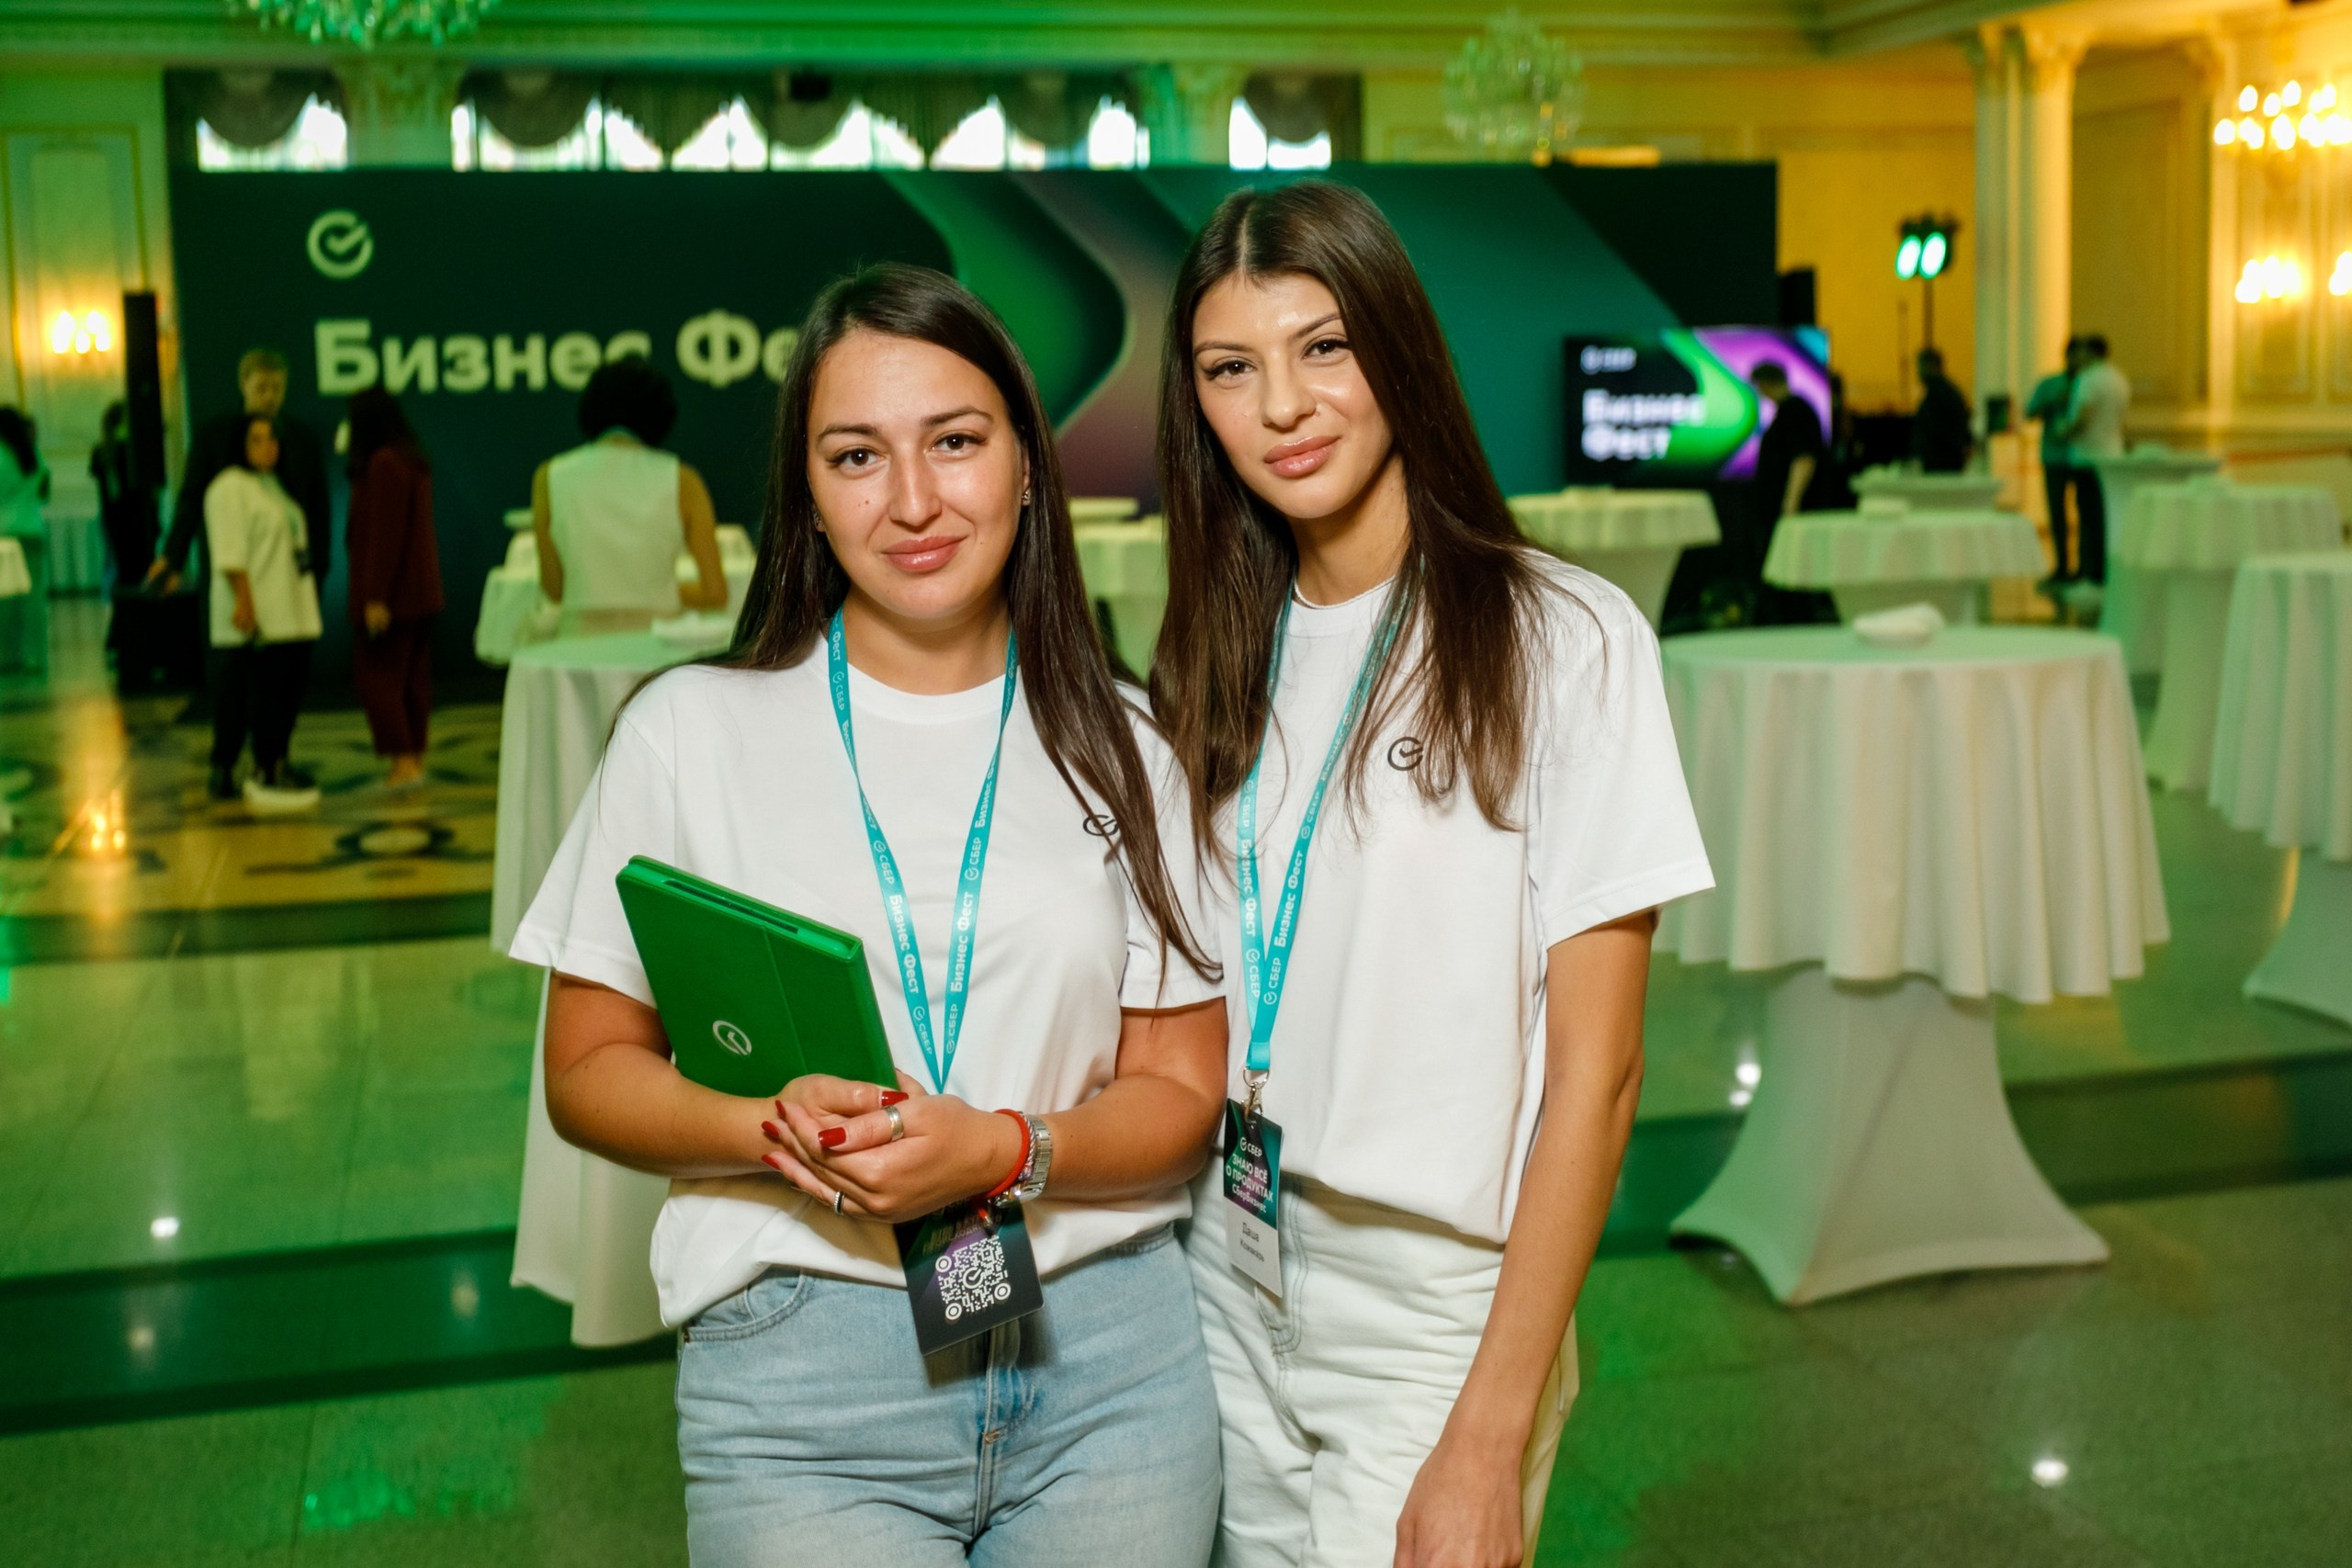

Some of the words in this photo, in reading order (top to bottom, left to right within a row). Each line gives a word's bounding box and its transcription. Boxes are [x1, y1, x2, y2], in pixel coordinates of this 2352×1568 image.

[674, 308, 795, 388] Фе
[831, 631, 842, 661] Фест
[835, 685, 845, 711] СБЕР
[975, 781, 992, 829] Бизнес
[969, 837, 982, 865] СБЕР
[1241, 839, 1254, 895] Бизнес
[1288, 850, 1304, 889] Фест
[956, 891, 974, 931] Фест
[1244, 897, 1257, 937] Фест
[1273, 892, 1296, 948] Бизнес
[879, 854, 896, 886] СБЕР
[888, 895, 910, 952] Бизнес
[903, 953, 920, 994] Фест
[918, 1022, 933, 1056] СБЕР
[950, 935, 969, 993] Бизнес
[1269, 957, 1282, 989] СБЕР
[1249, 965, 1261, 998] СБЕР
[947, 1003, 959, 1037] СБЕР
[1232, 1154, 1253, 1174] ЗНАЮ
[1254, 1167, 1268, 1184] ВСЁ
[1247, 1143, 1262, 1157] СБЕР
[1226, 1165, 1232, 1177] О
[1232, 1168, 1273, 1203] ПРОДУКТАХ
